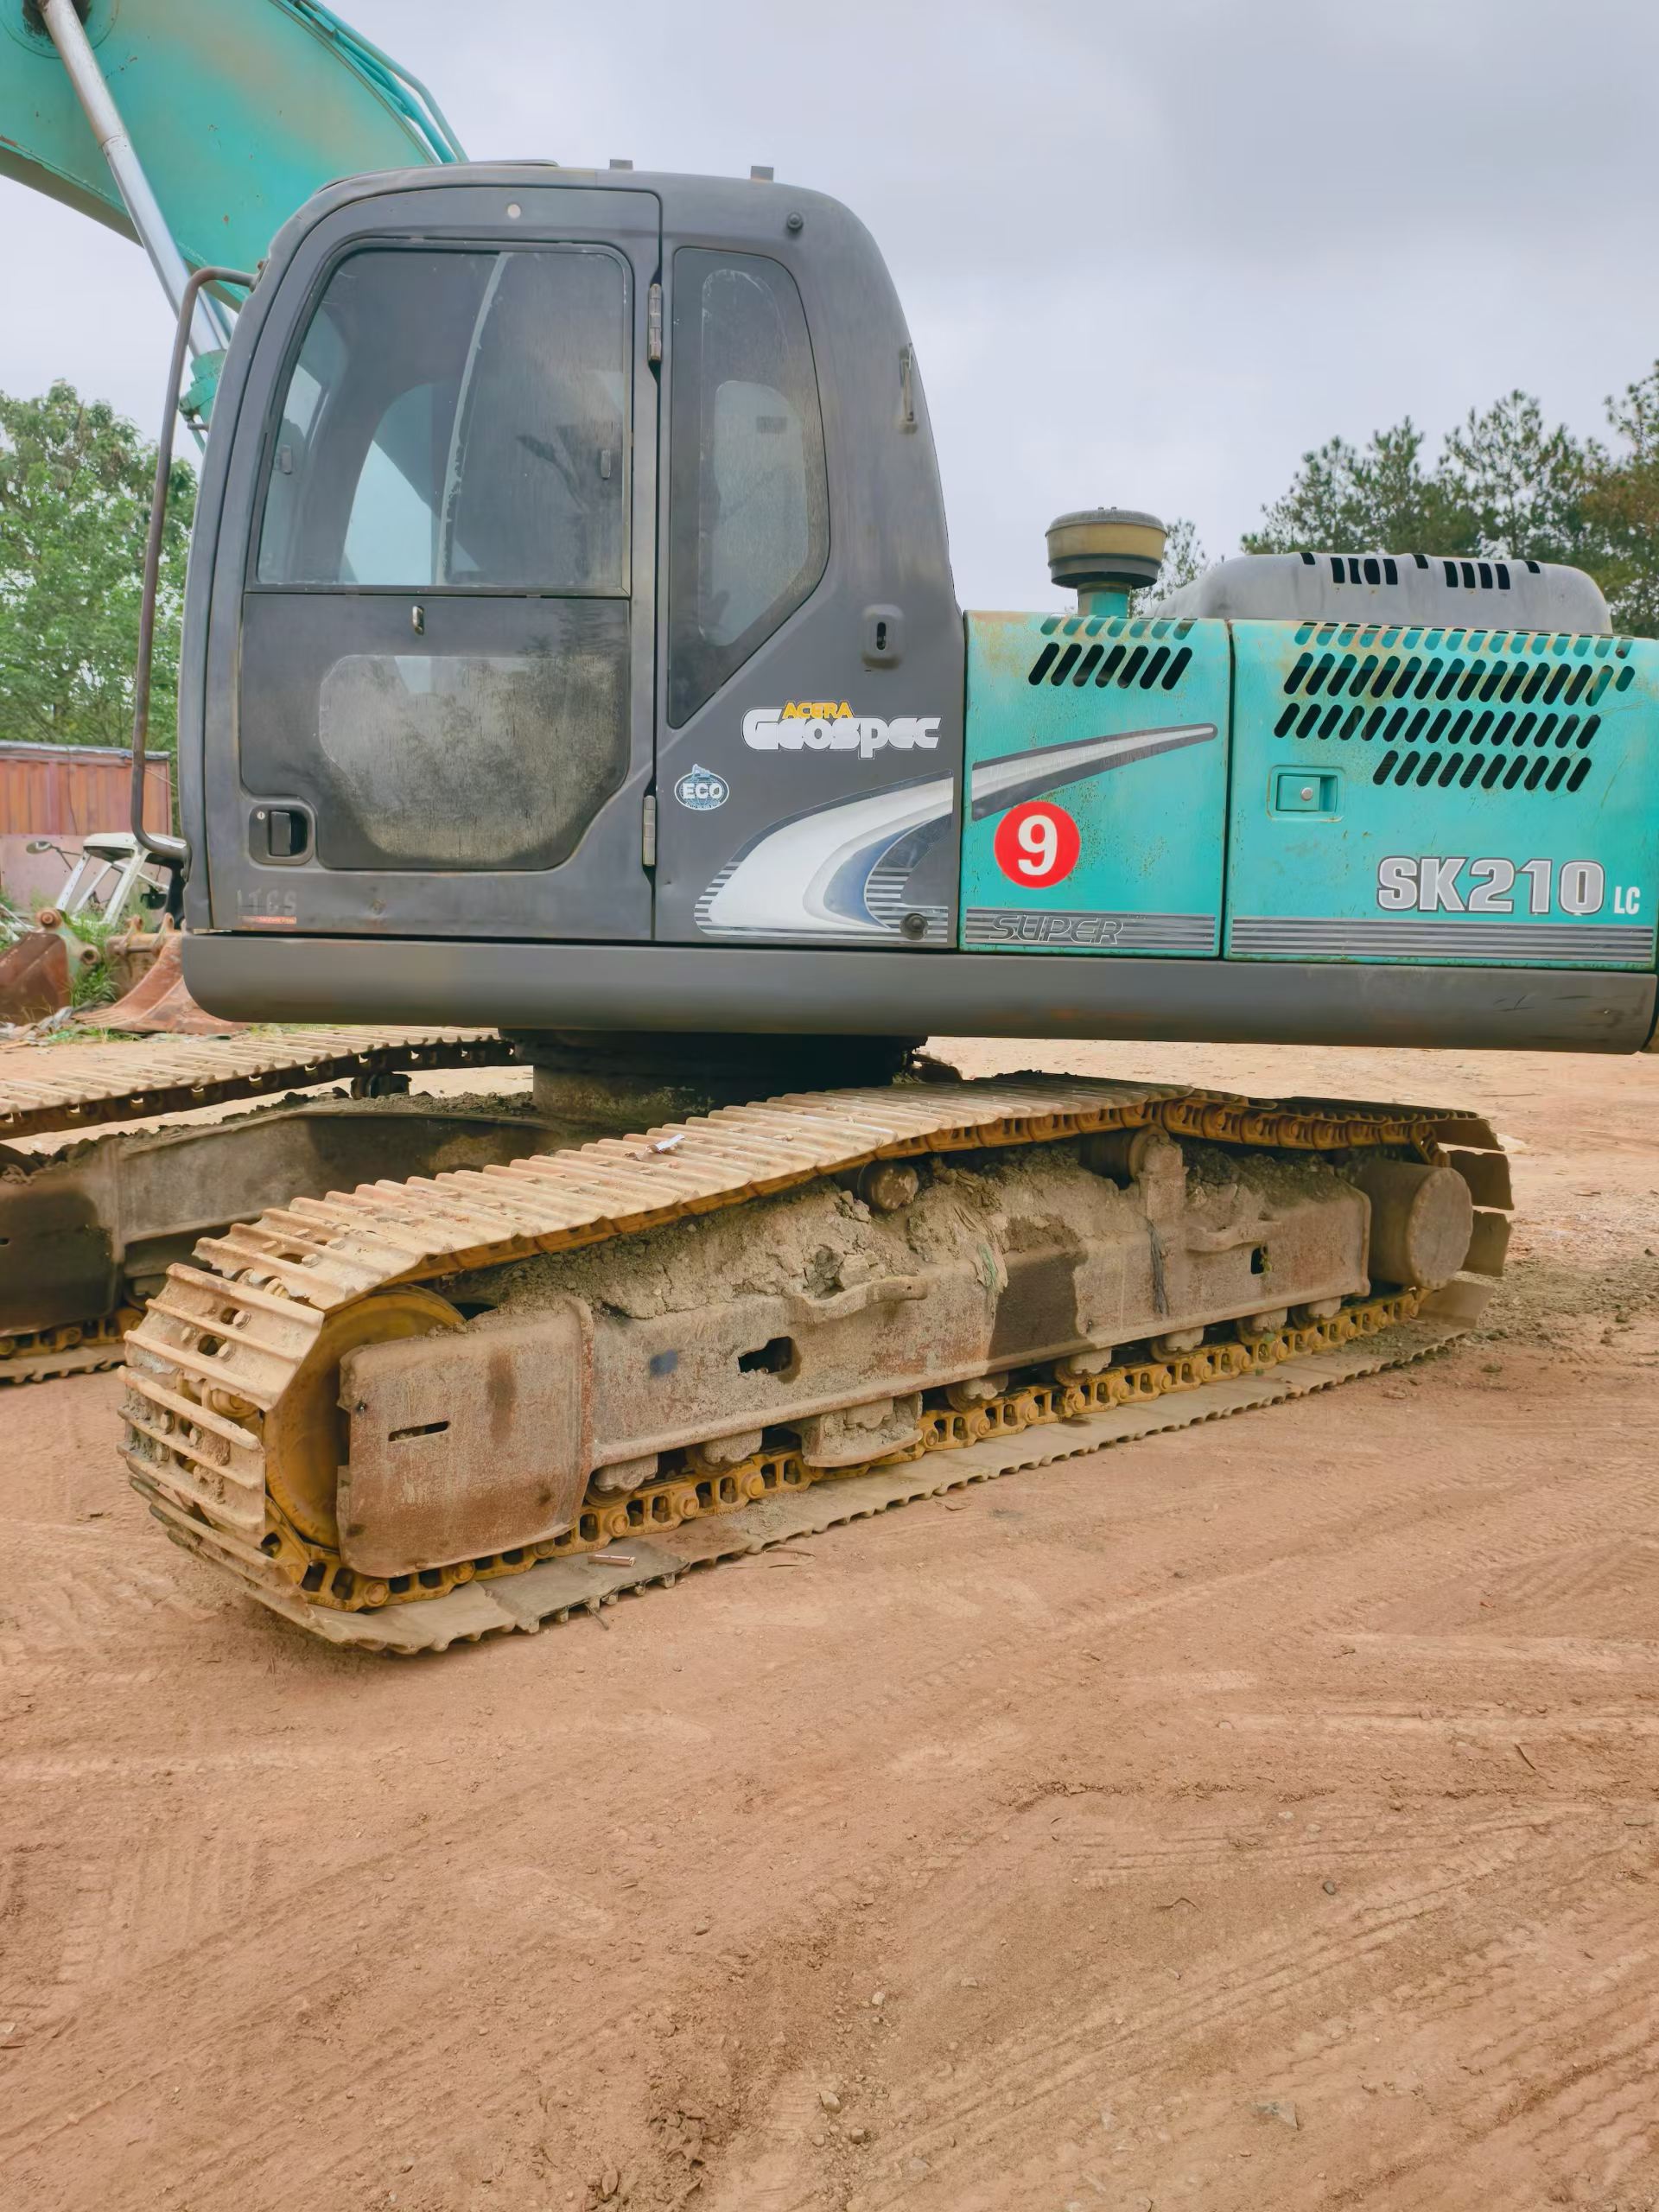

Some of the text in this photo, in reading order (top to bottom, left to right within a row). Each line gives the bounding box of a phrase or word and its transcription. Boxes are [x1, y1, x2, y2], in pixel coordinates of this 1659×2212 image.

[683, 783, 723, 799] ECO
[1017, 814, 1058, 876] 9
[1376, 855, 1641, 915] SK210 LC
[988, 913, 1123, 945] SUPER
